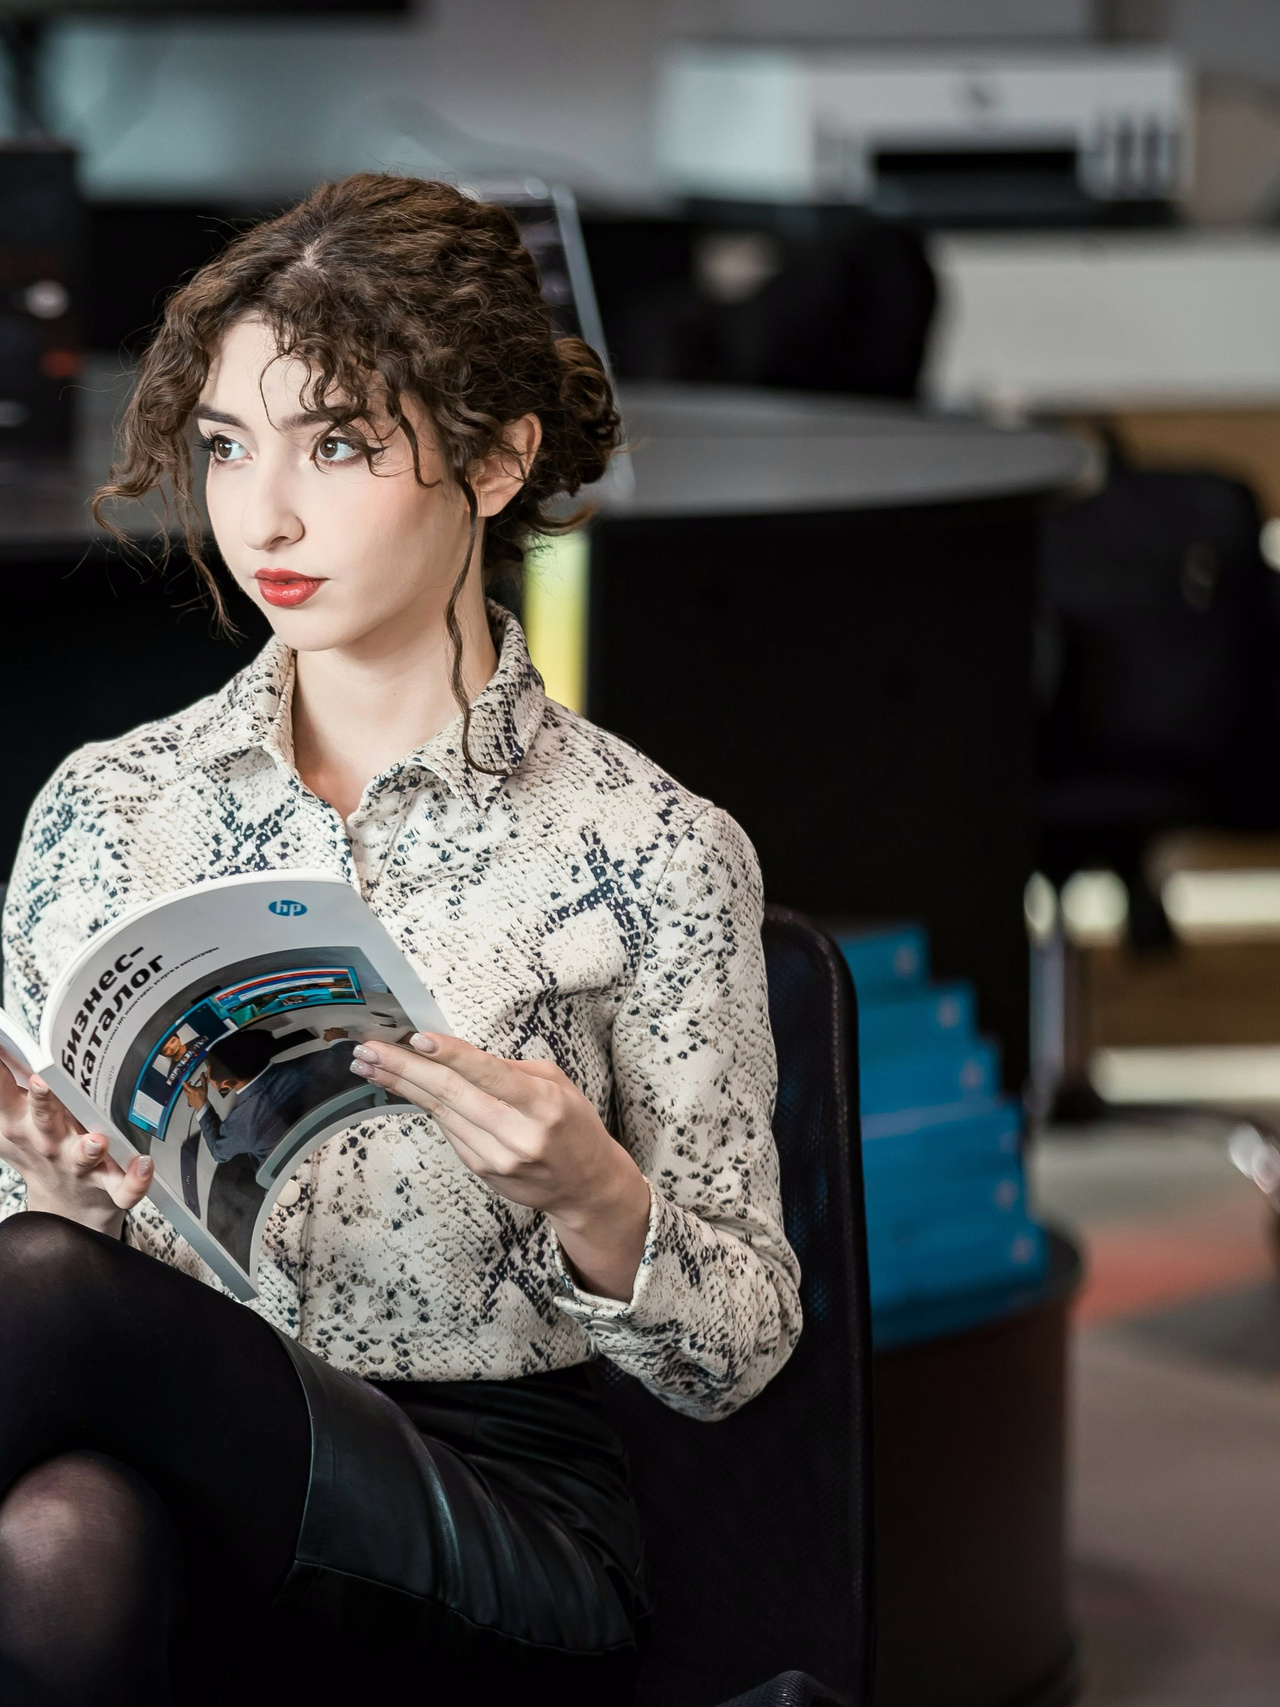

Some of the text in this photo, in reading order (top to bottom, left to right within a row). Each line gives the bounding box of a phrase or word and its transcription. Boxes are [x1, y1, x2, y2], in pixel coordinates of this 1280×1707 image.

[275, 899, 303, 917] hp
[61, 946, 145, 1080] Бизнес-
[80, 954, 164, 1097] каталог
